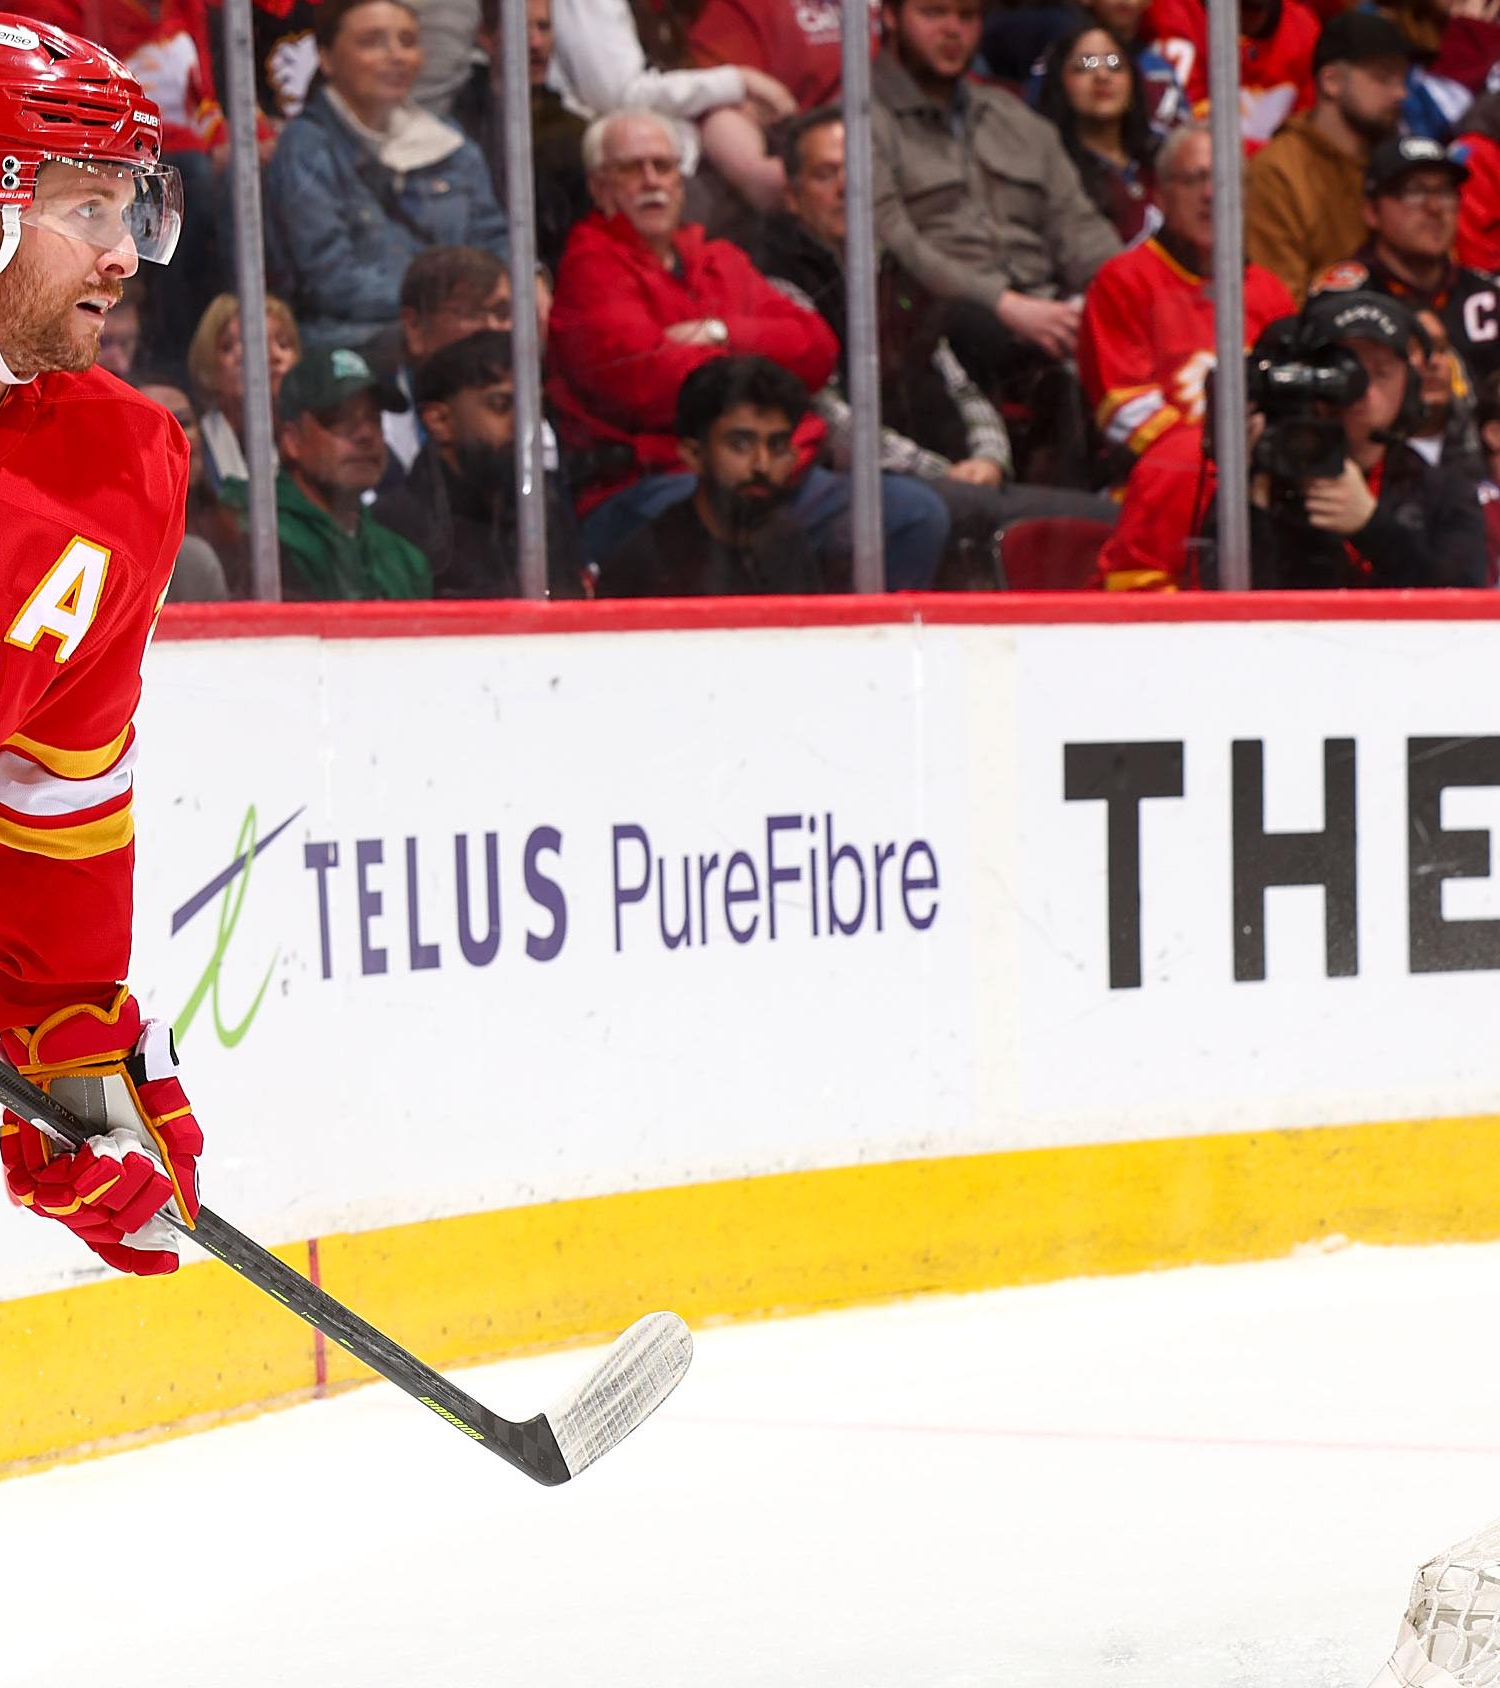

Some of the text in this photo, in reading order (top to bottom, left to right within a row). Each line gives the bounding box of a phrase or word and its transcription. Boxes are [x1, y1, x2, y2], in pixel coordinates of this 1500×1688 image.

[133, 110, 161, 127] BAUE
[1463, 292, 1498, 342] C
[4, 535, 112, 664] A
[304, 812, 940, 979] TELUS PureFibre
[418, 1396, 485, 1440] WARRIOR
